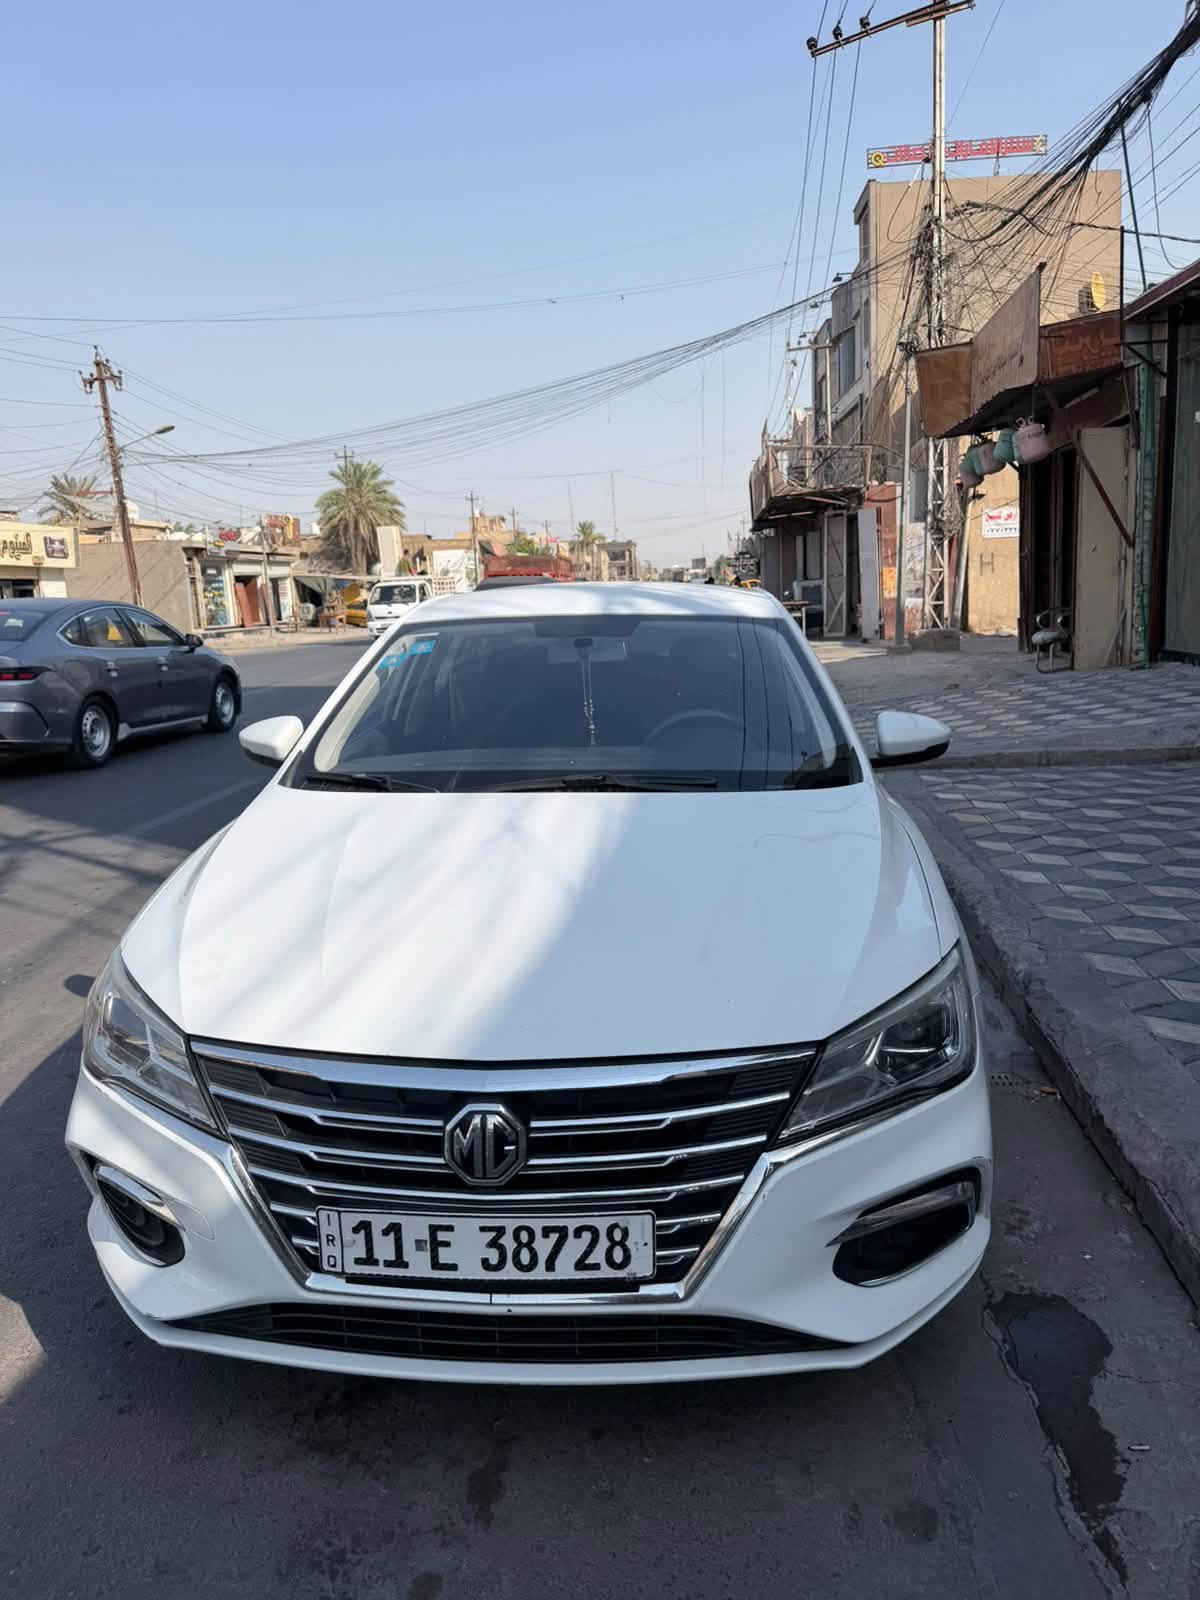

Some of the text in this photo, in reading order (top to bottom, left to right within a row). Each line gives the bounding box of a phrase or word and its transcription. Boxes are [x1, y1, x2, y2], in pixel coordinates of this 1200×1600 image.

[454, 1114, 516, 1177] MG
[351, 1219, 632, 1273] 11 E 38728
